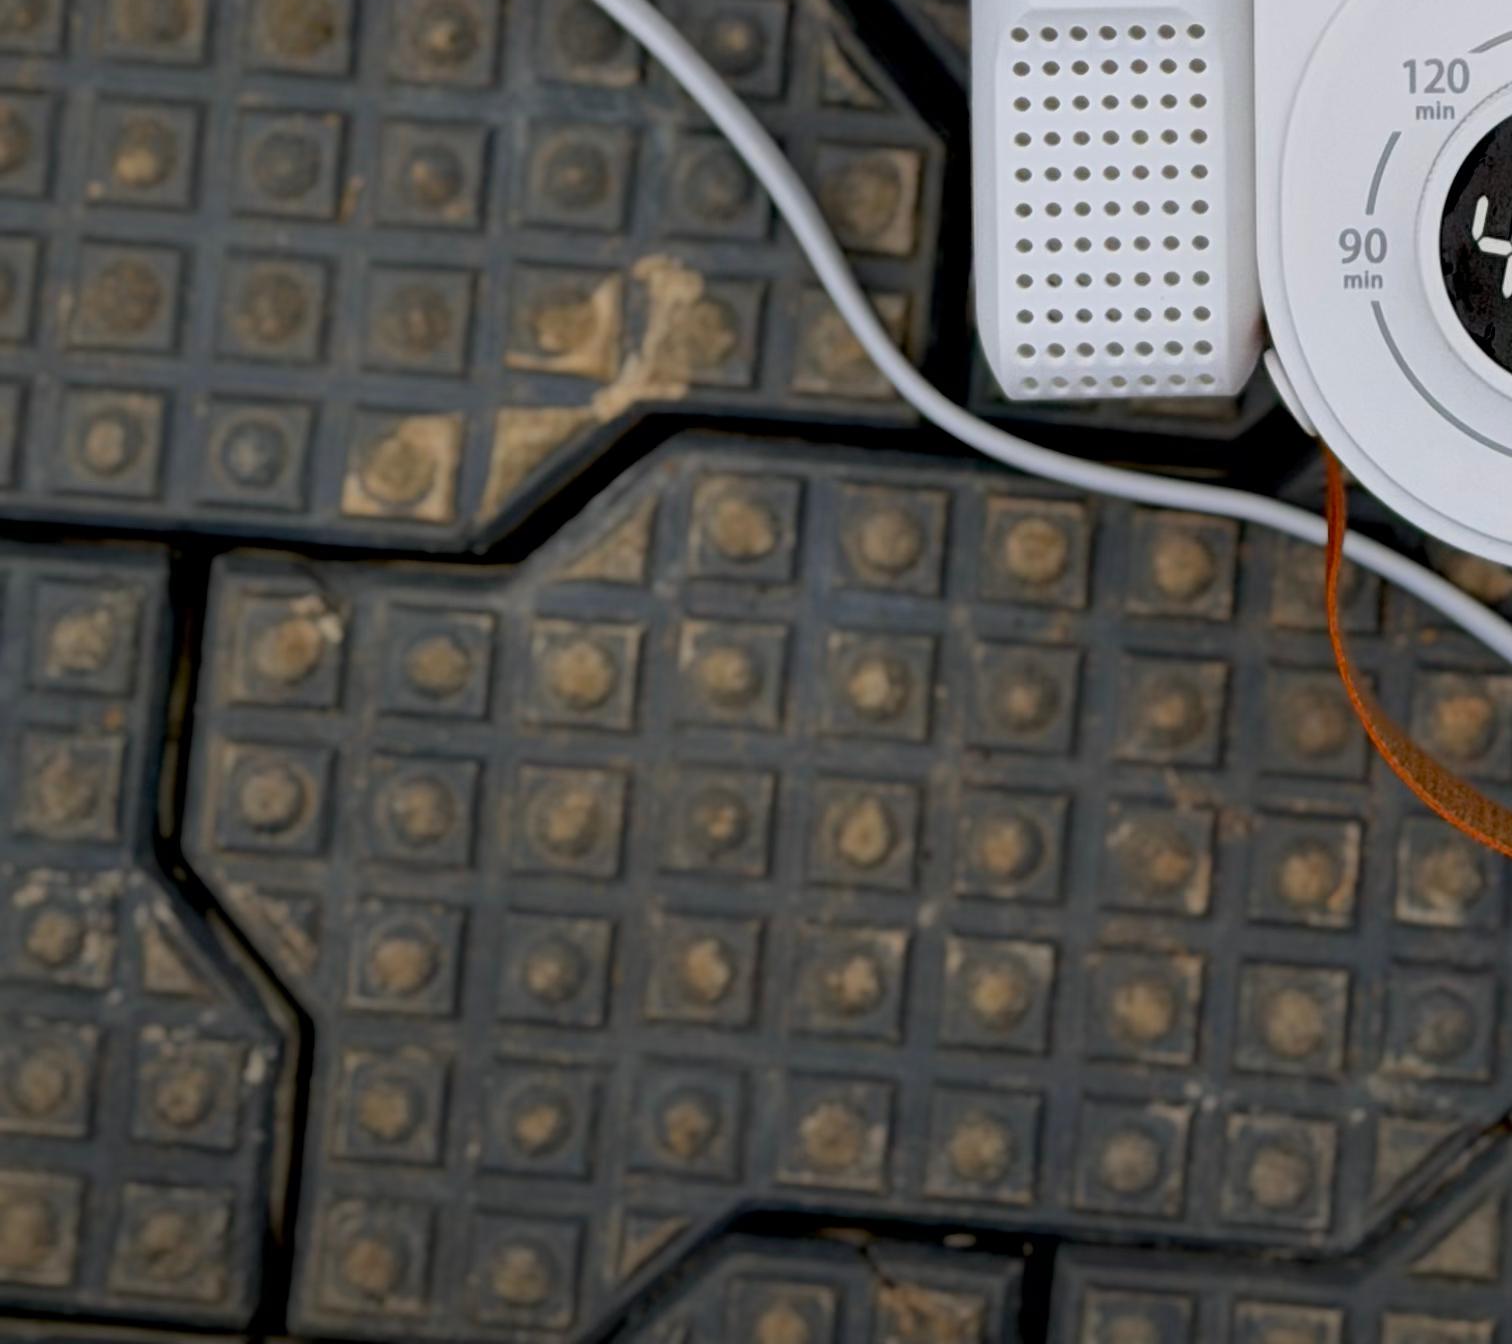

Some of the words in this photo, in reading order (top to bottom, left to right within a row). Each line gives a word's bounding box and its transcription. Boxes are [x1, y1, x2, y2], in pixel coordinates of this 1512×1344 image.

[1403, 58, 1471, 95] 120
[1415, 101, 1456, 121] min
[1338, 228, 1387, 264] 90
[1343, 270, 1383, 290] min
